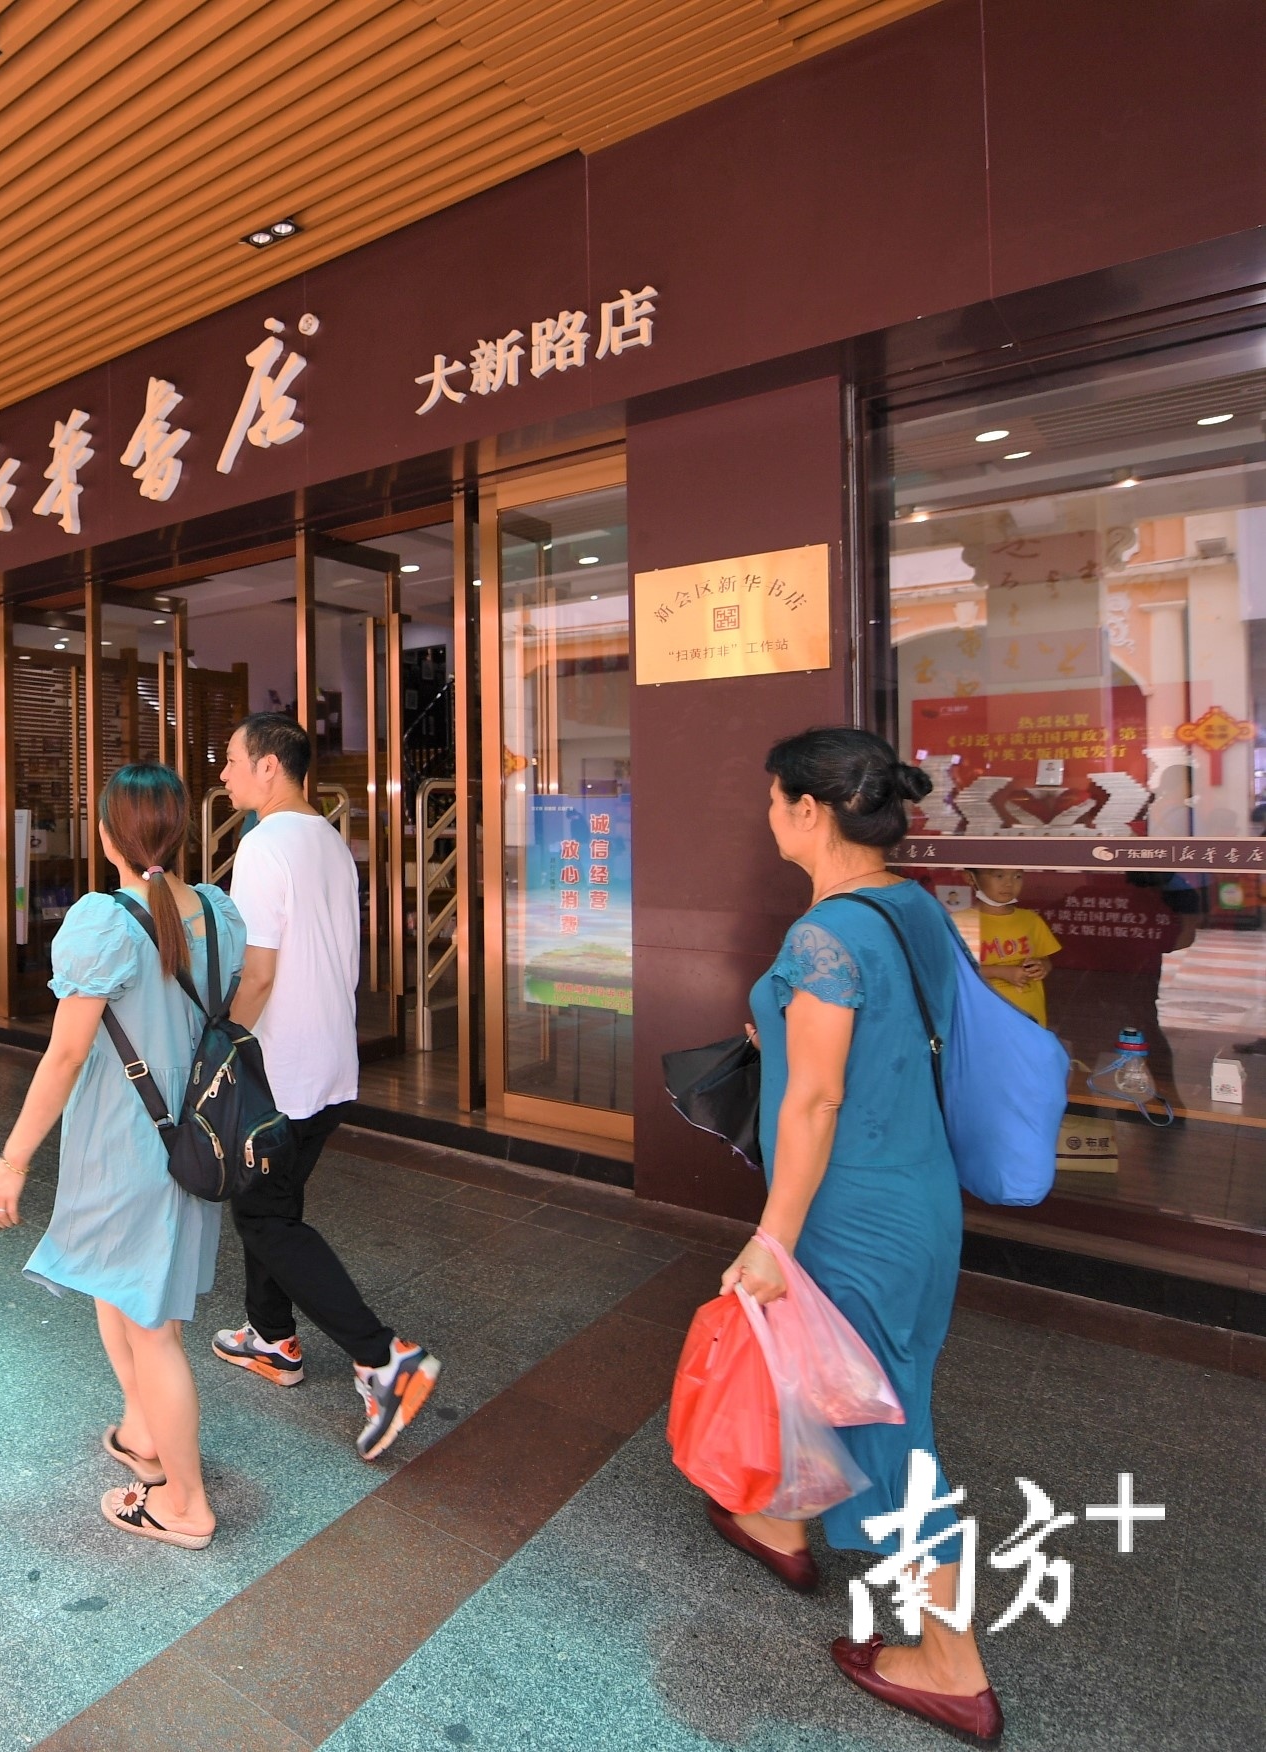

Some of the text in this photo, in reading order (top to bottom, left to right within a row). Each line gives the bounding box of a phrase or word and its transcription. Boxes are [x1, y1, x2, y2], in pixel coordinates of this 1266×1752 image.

[414, 285, 658, 416] 大新路店
[654, 573, 807, 624] 新会区新华书店
[1018, 713, 1089, 729] 热烈祝贺
[984, 744, 1127, 761] 中英文版出版发行
[589, 813, 610, 910] 诚信经营
[1114, 848, 1168, 859] 广东新华
[559, 839, 580, 936] 放心消费
